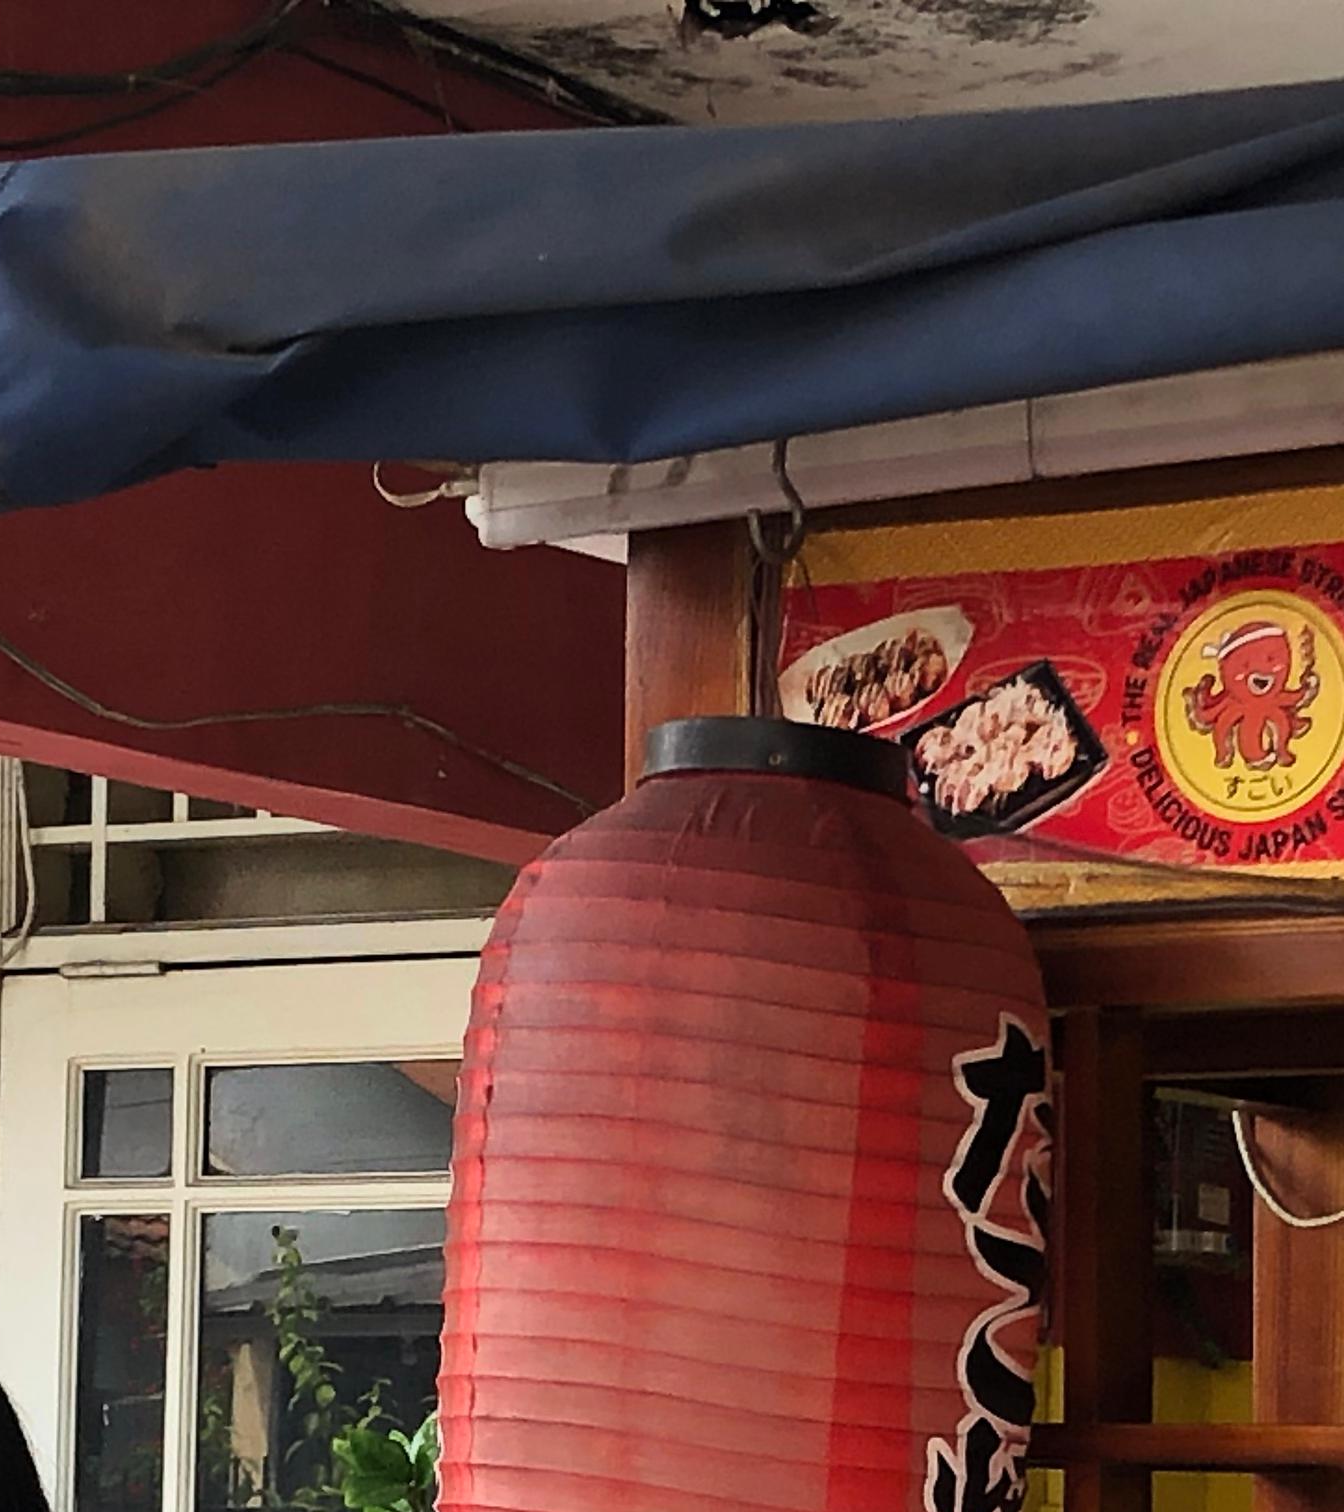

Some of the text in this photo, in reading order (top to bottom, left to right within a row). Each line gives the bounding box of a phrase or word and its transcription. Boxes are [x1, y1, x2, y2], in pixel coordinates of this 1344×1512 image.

[1178, 546, 1297, 608] JAPANESE
[1132, 613, 1178, 670] REAL
[1122, 676, 1147, 727] THE
[1130, 745, 1231, 857] DELICIOUS
[1238, 813, 1328, 860] JAPAN
[1224, 775, 1293, 801] すごい
